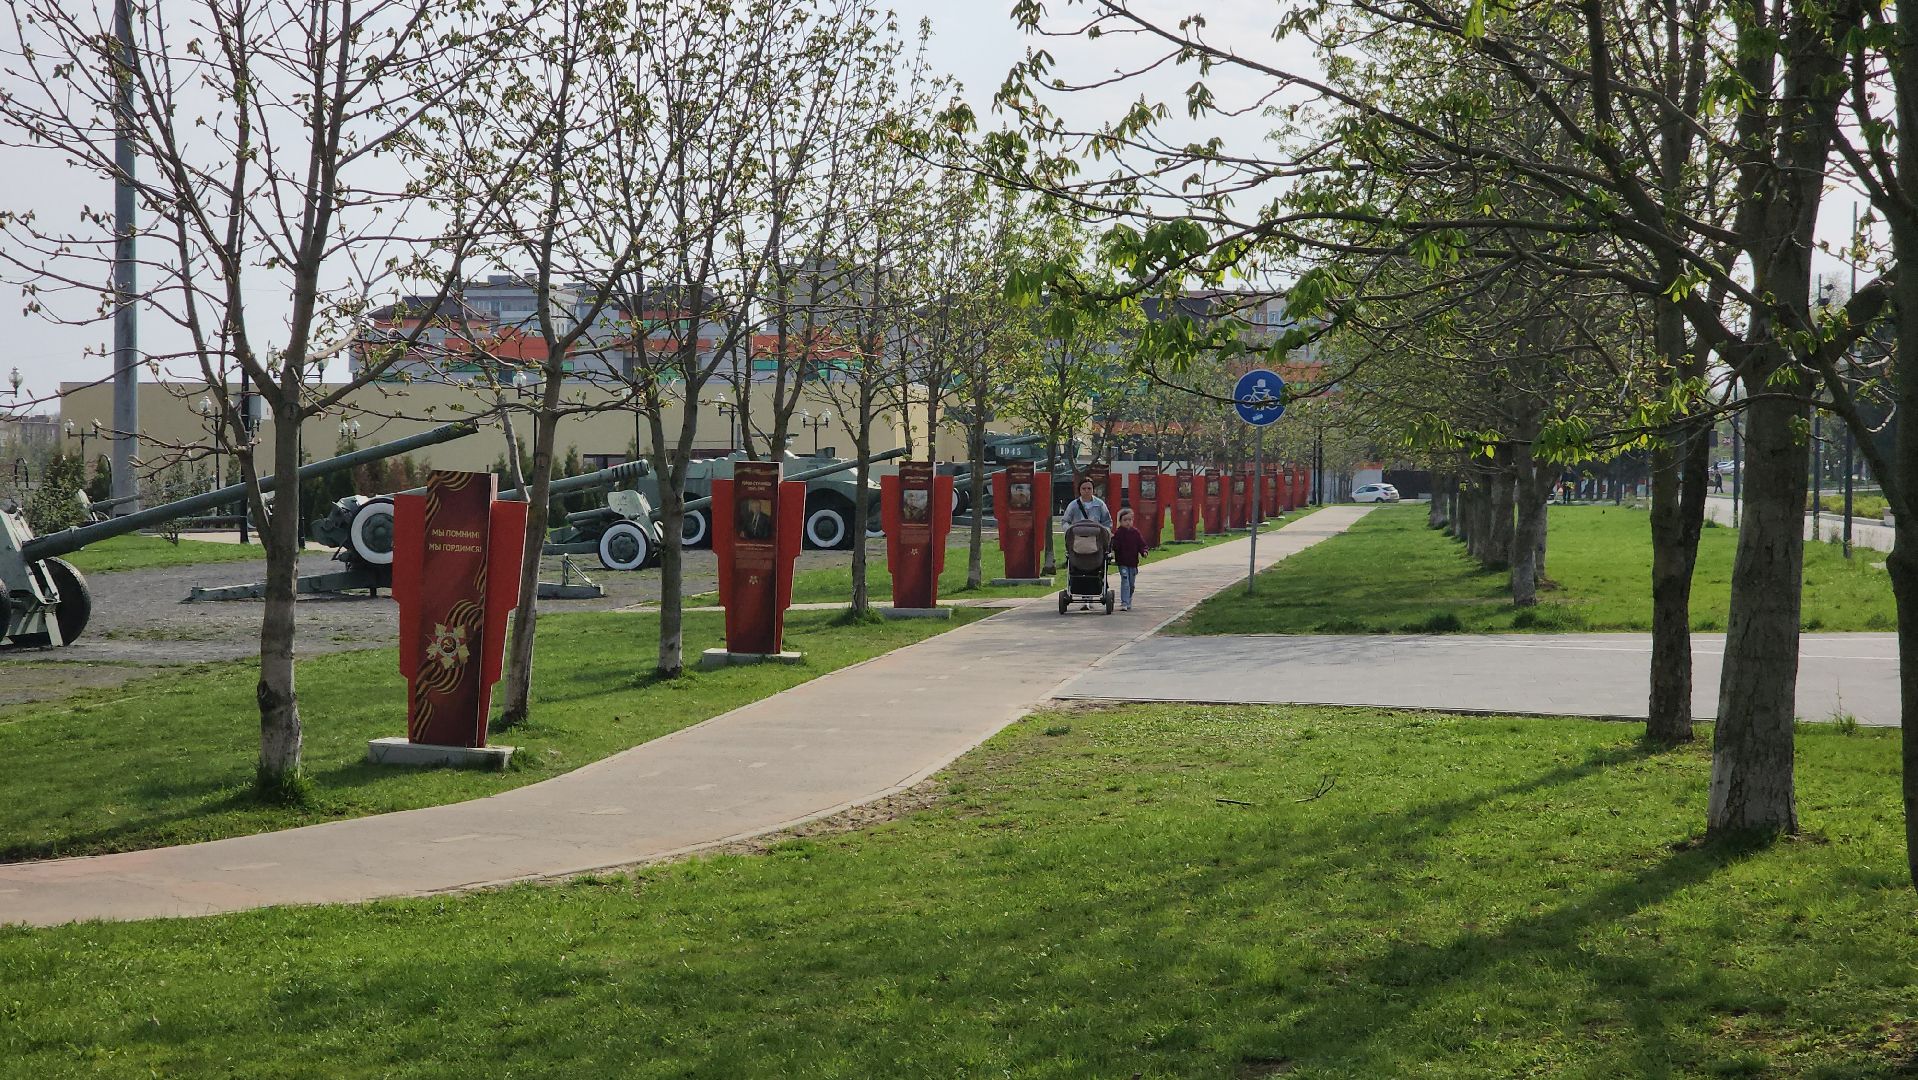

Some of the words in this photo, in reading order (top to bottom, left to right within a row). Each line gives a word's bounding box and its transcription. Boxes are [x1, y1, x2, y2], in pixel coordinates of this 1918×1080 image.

[1000, 447, 1021, 456] 1945
[432, 529, 445, 537] МЫ
[446, 530, 480, 539] ПОМНИМ!
[442, 544, 482, 552] ГОРДИМСЯ!
